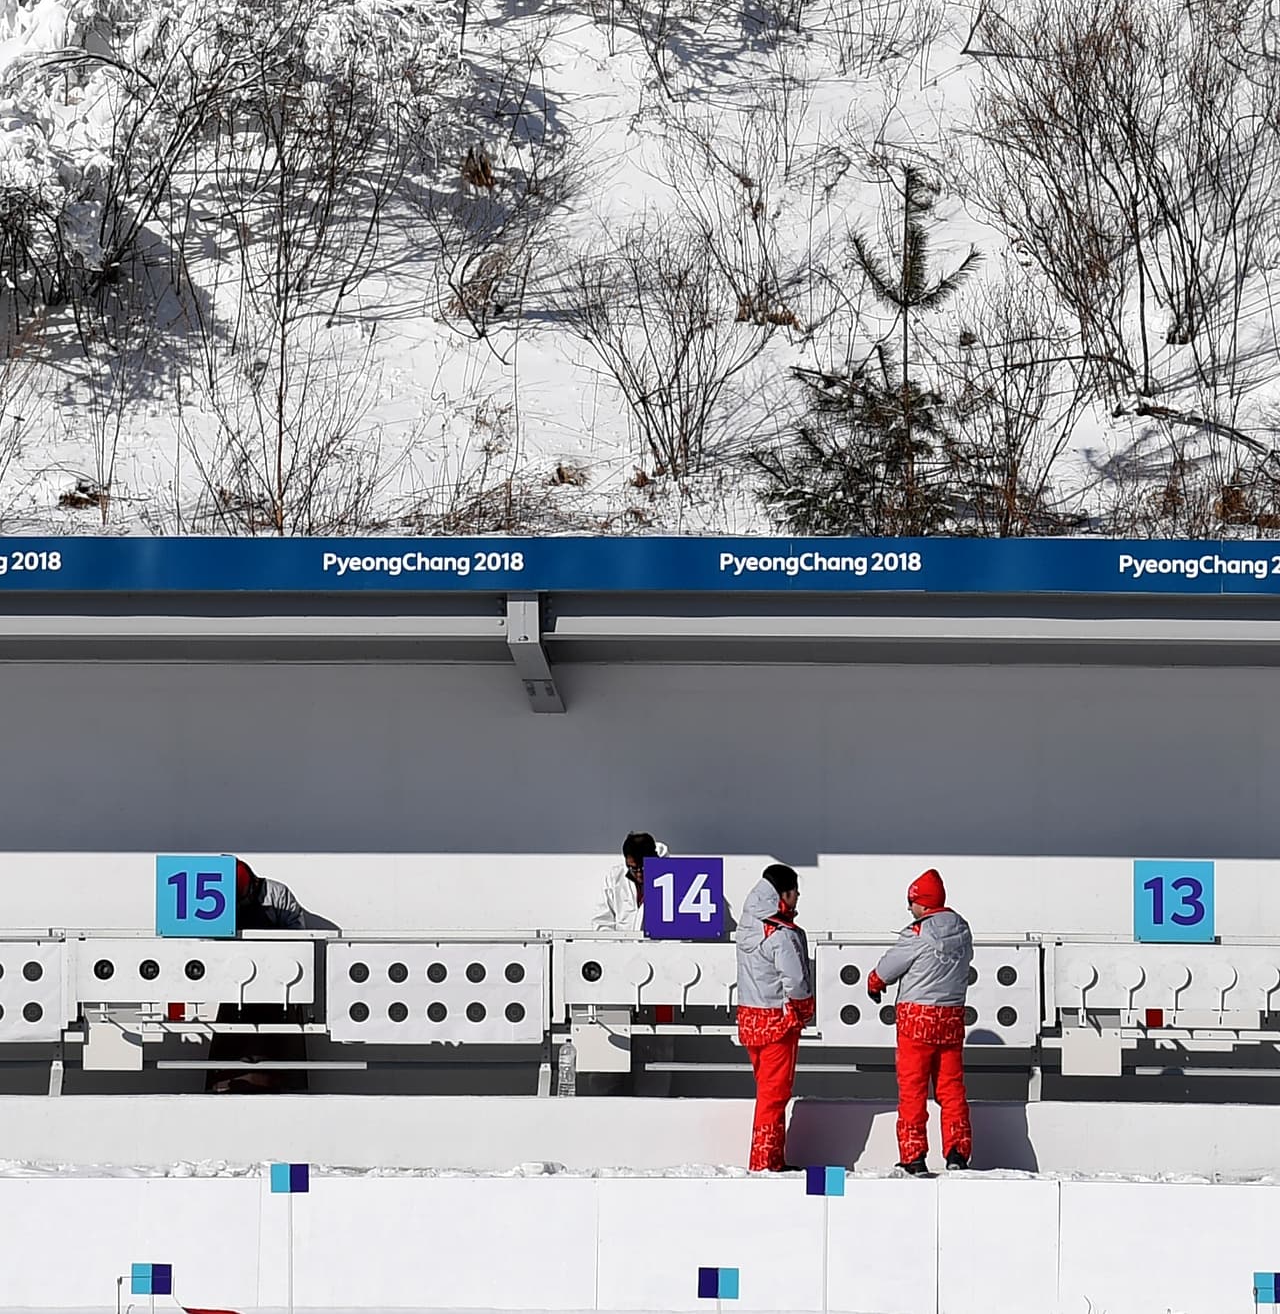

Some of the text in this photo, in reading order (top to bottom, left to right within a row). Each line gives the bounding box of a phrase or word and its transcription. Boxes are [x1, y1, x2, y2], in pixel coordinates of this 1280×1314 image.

[12, 552, 61, 570] 2018
[324, 553, 523, 575] PyeongChang 2018
[720, 552, 921, 576] PyeongChang 2018
[1120, 555, 1267, 578] PyeongChang
[167, 872, 226, 921] 15
[653, 873, 717, 922] 14
[1143, 876, 1205, 926] 13
